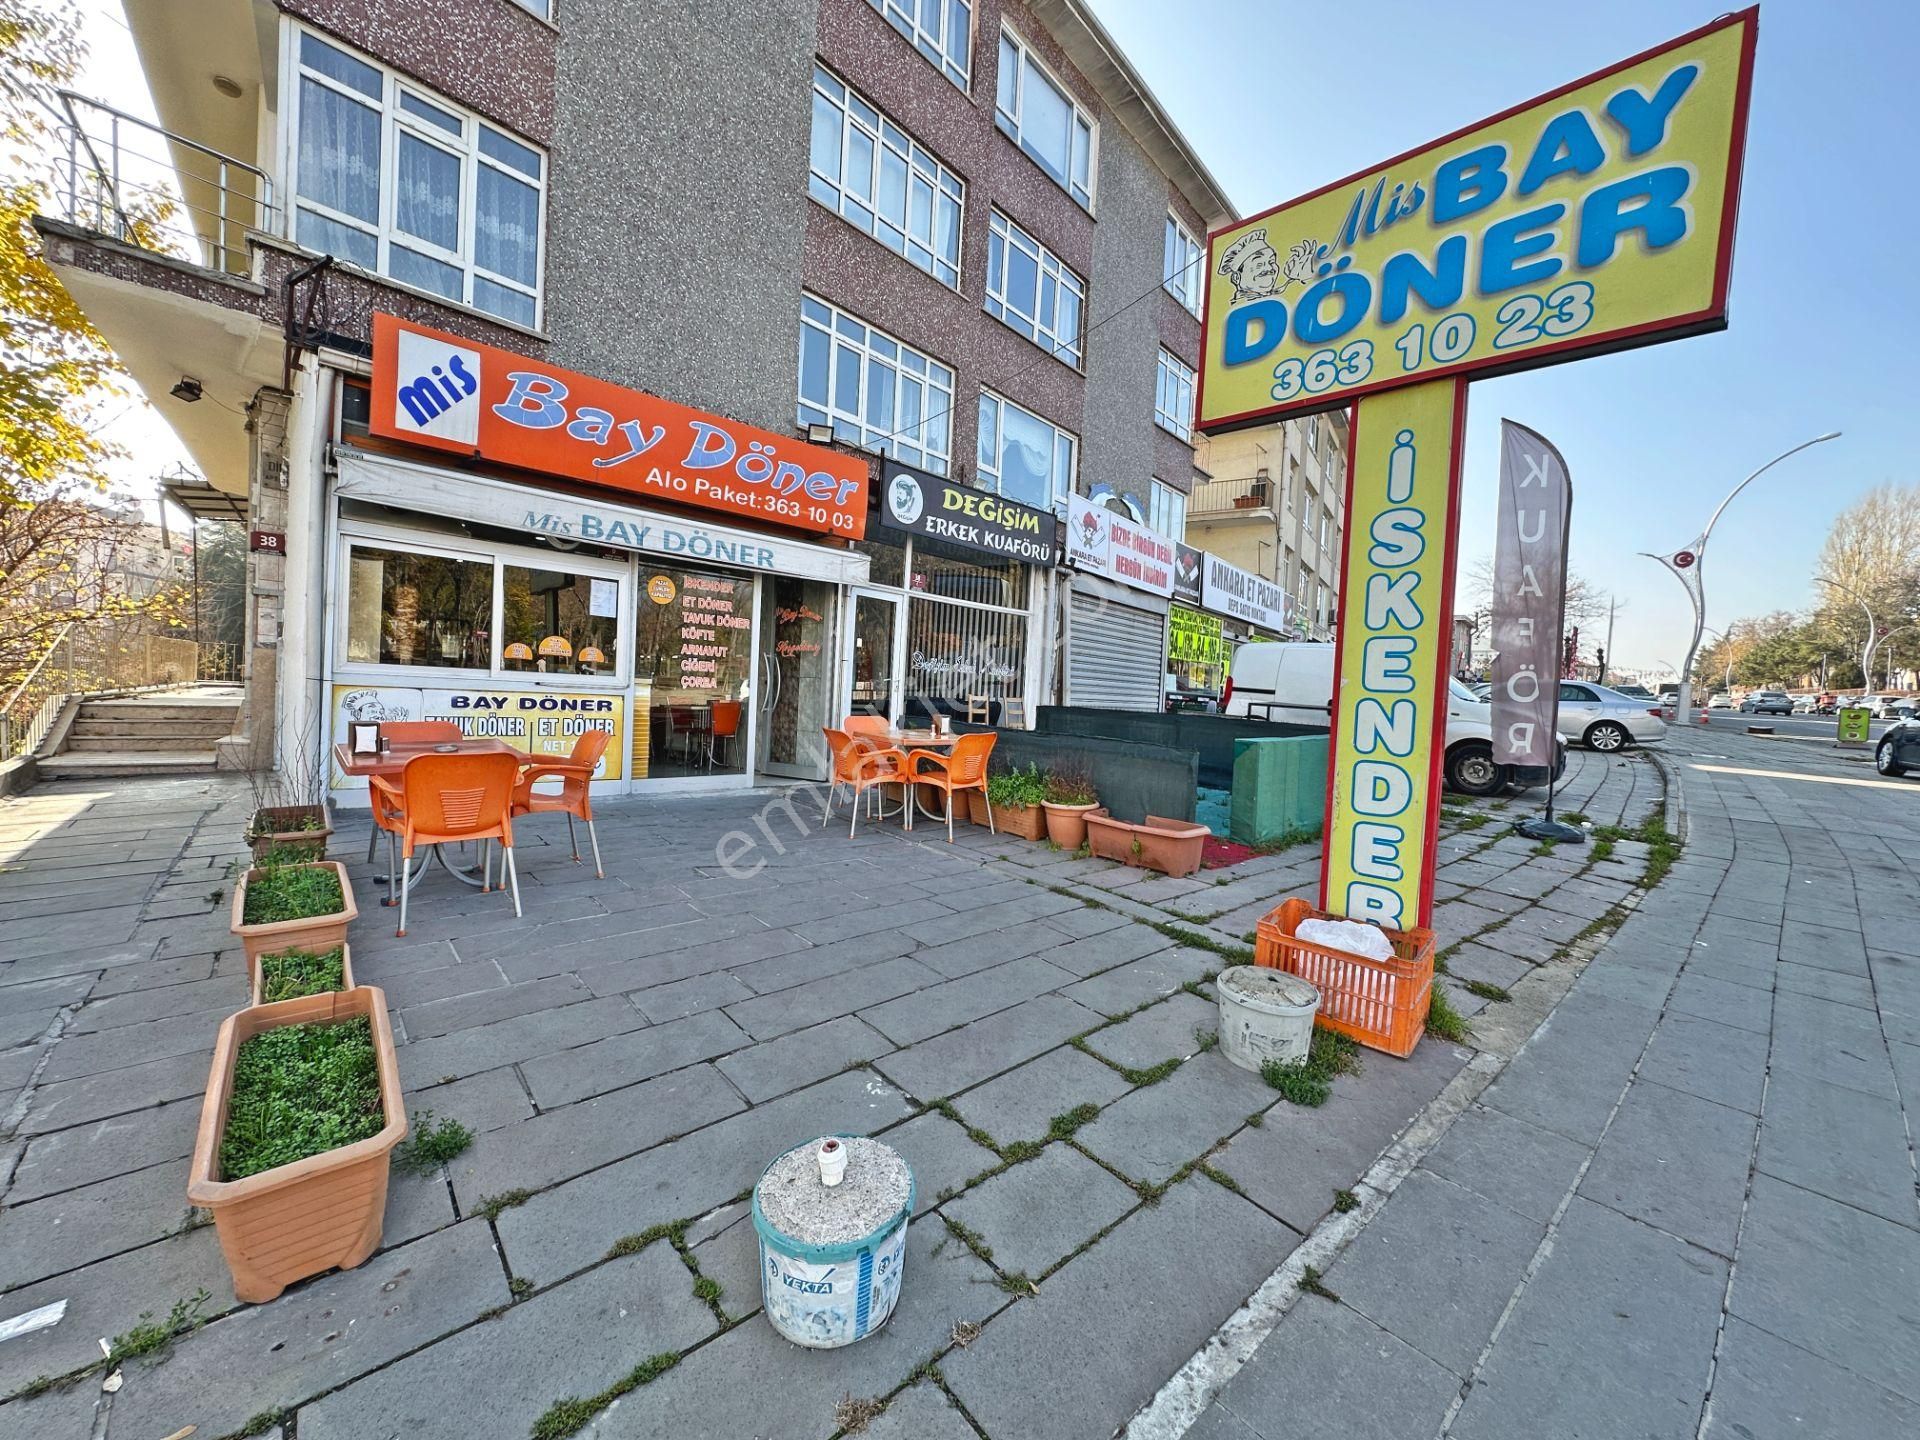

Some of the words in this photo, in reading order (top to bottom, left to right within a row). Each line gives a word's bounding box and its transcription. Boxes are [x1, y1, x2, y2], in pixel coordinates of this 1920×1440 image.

[1315, 175, 1426, 260] Mis
[1433, 64, 1700, 225] BAY
[1222, 166, 1692, 368] DÖNER
[1270, 339, 1374, 402] 363
[1396, 312, 1476, 371] 10
[1493, 280, 1595, 349] 23
[492, 371, 666, 468] Bay
[680, 420, 860, 506] Döner
[645, 466, 688, 491] Alo
[808, 506, 828, 524] 10
[832, 511, 854, 530] 03
[942, 487, 1040, 534] DEĞİŞİM
[259, 535, 277, 548] 38
[522, 510, 573, 536] Mis
[581, 513, 652, 546] BAY
[663, 529, 775, 568] DÖNER
[925, 515, 979, 544] ERKEK
[983, 530, 1051, 561] KUAFÖRÜ
[1210, 560, 1245, 599] ANKARA
[1246, 577, 1256, 603] ET
[1257, 581, 1281, 613] PAZARI
[682, 595, 697, 608] ET
[697, 596, 733, 612] DÖNER
[682, 611, 716, 626] TAVUK
[716, 614, 750, 629] DÖNER
[681, 626, 716, 642] KÖFTE
[680, 643, 729, 658] ARNAVUT
[680, 675, 717, 690] ÇORBA
[450, 695, 508, 710] BAY
[518, 694, 613, 712] DÖNER
[476, 712, 526, 737] DÖNER
[537, 717, 560, 737] ET
[543, 740, 567, 752] NET
[783, 1272, 833, 1295] YEKTA
